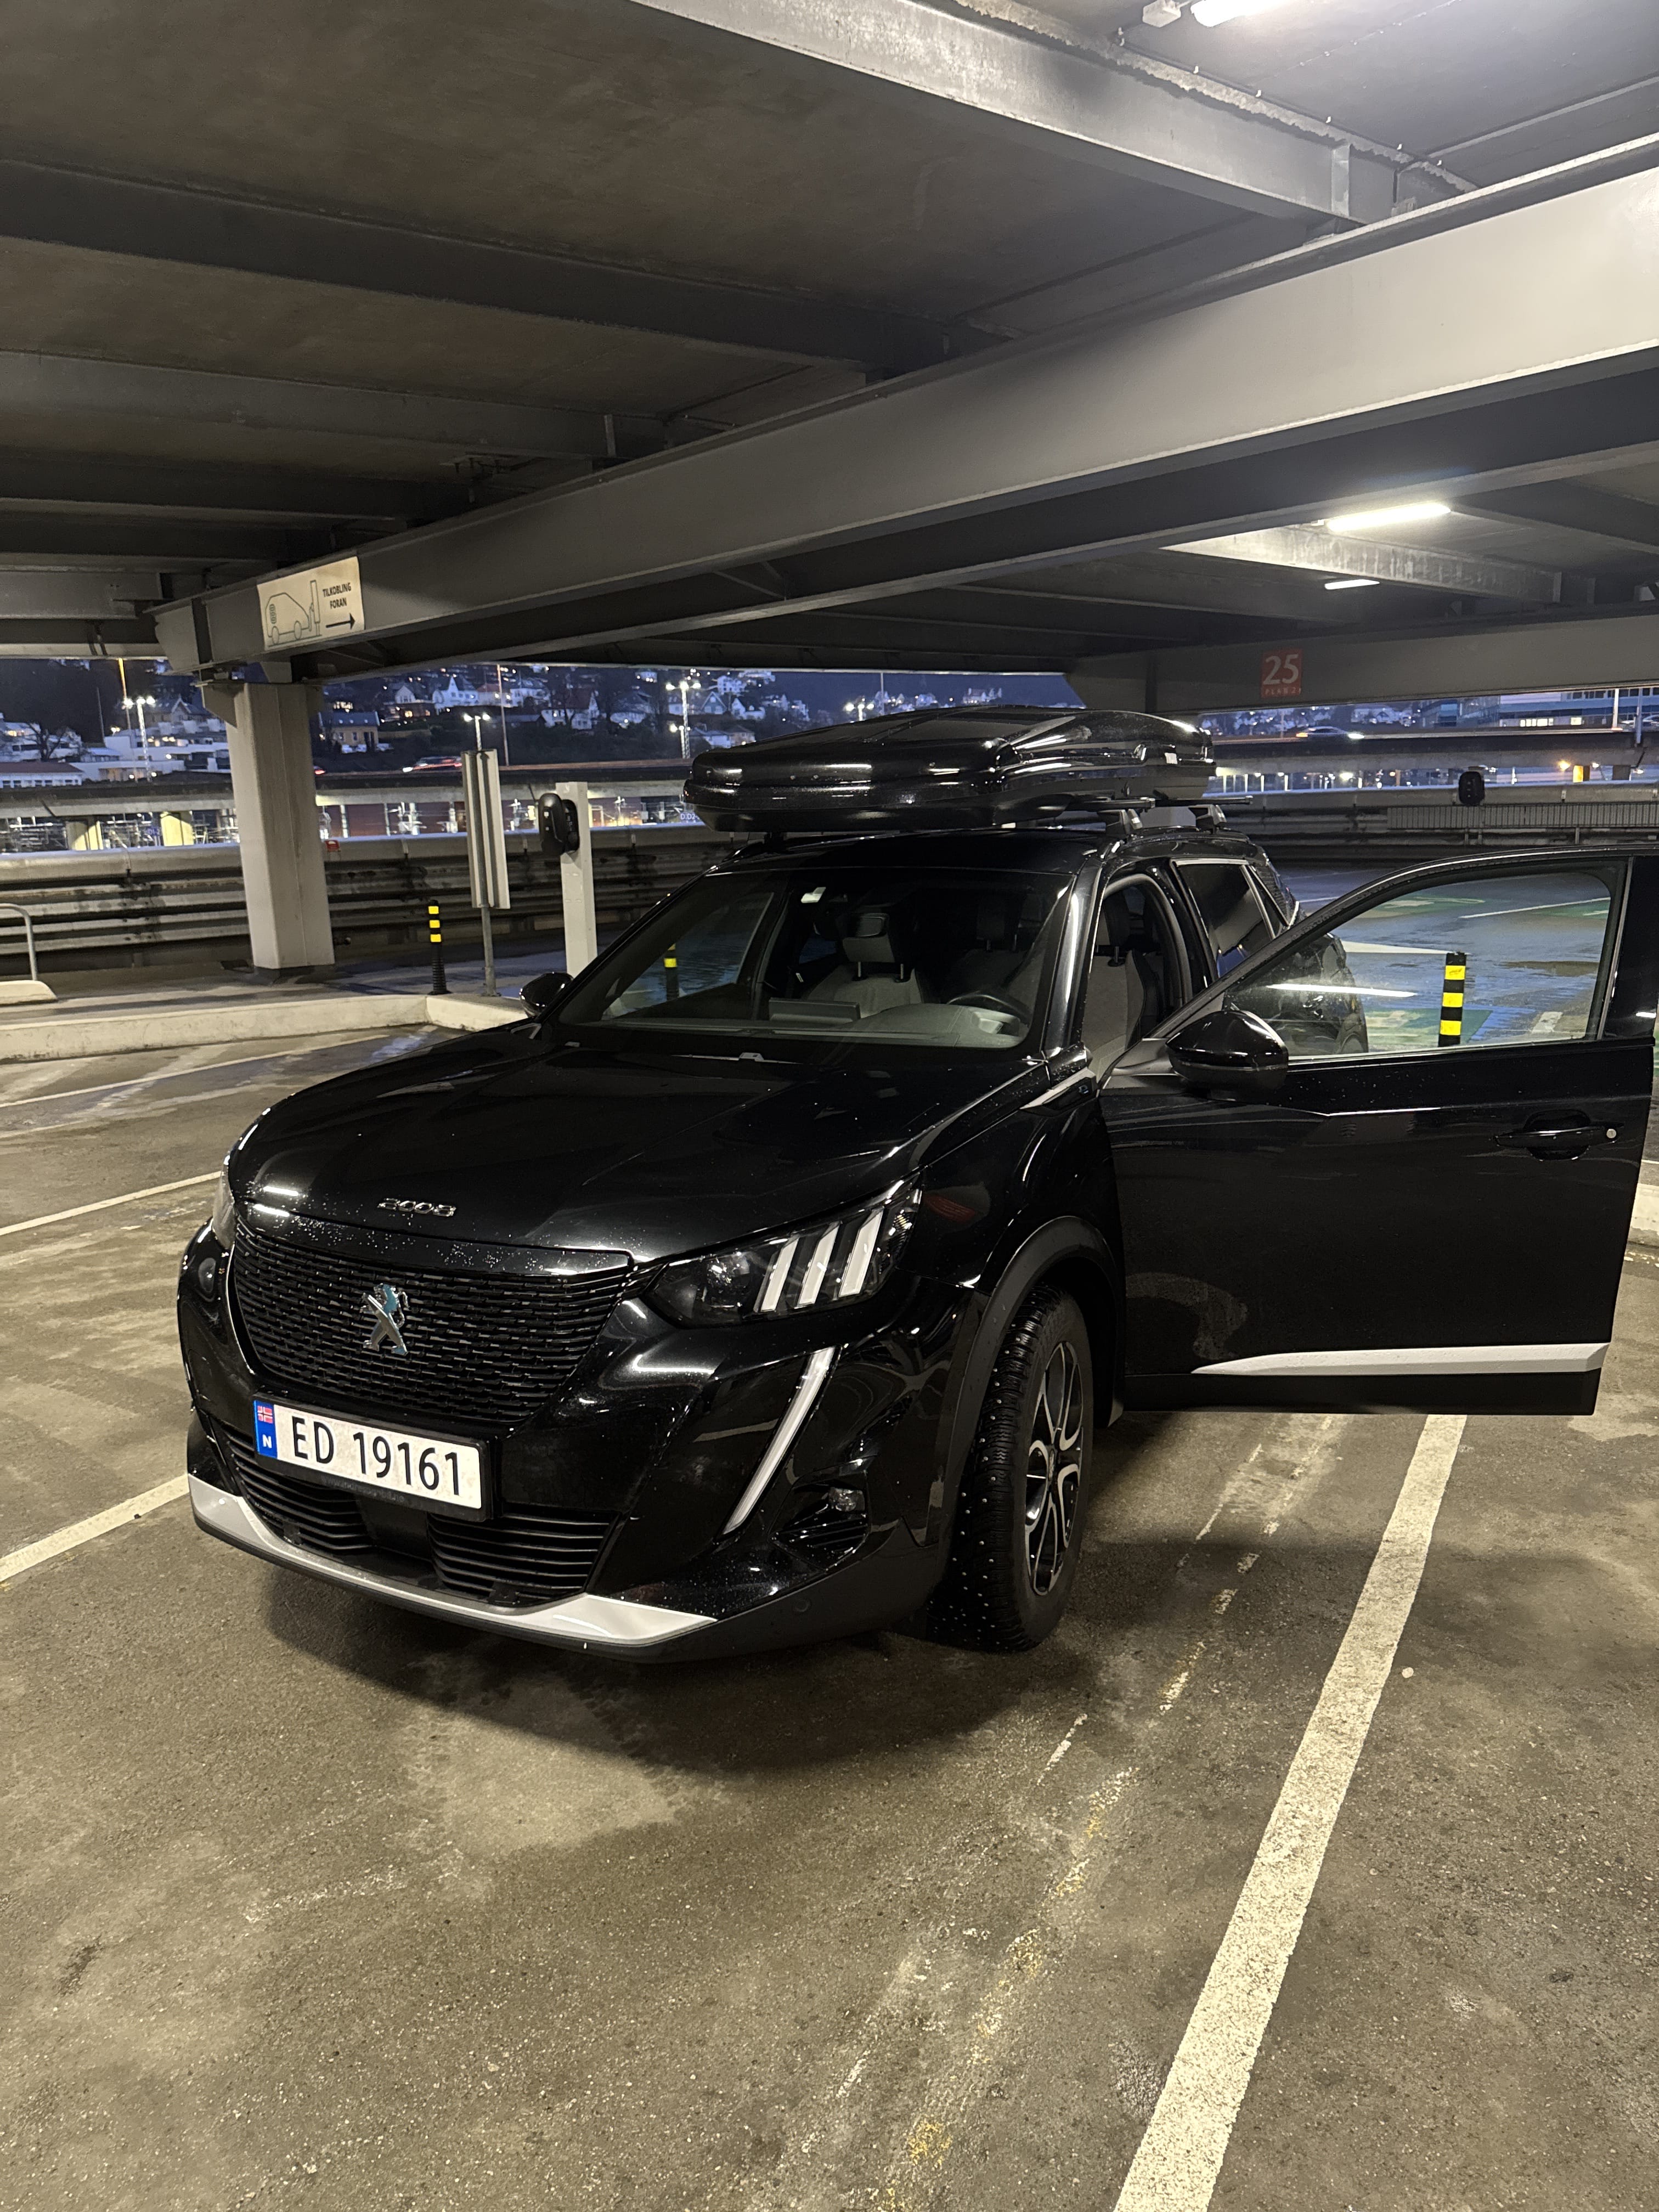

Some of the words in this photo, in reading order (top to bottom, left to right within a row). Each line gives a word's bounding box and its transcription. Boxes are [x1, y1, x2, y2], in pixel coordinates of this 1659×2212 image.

[323, 582, 352, 597] TILKOBLING
[330, 597, 347, 609] FORAN
[1263, 653, 1300, 685] 25
[377, 1198, 456, 1217] 2008
[262, 1434, 272, 1449] N
[292, 1416, 335, 1464] ED
[353, 1431, 460, 1496] 19161
